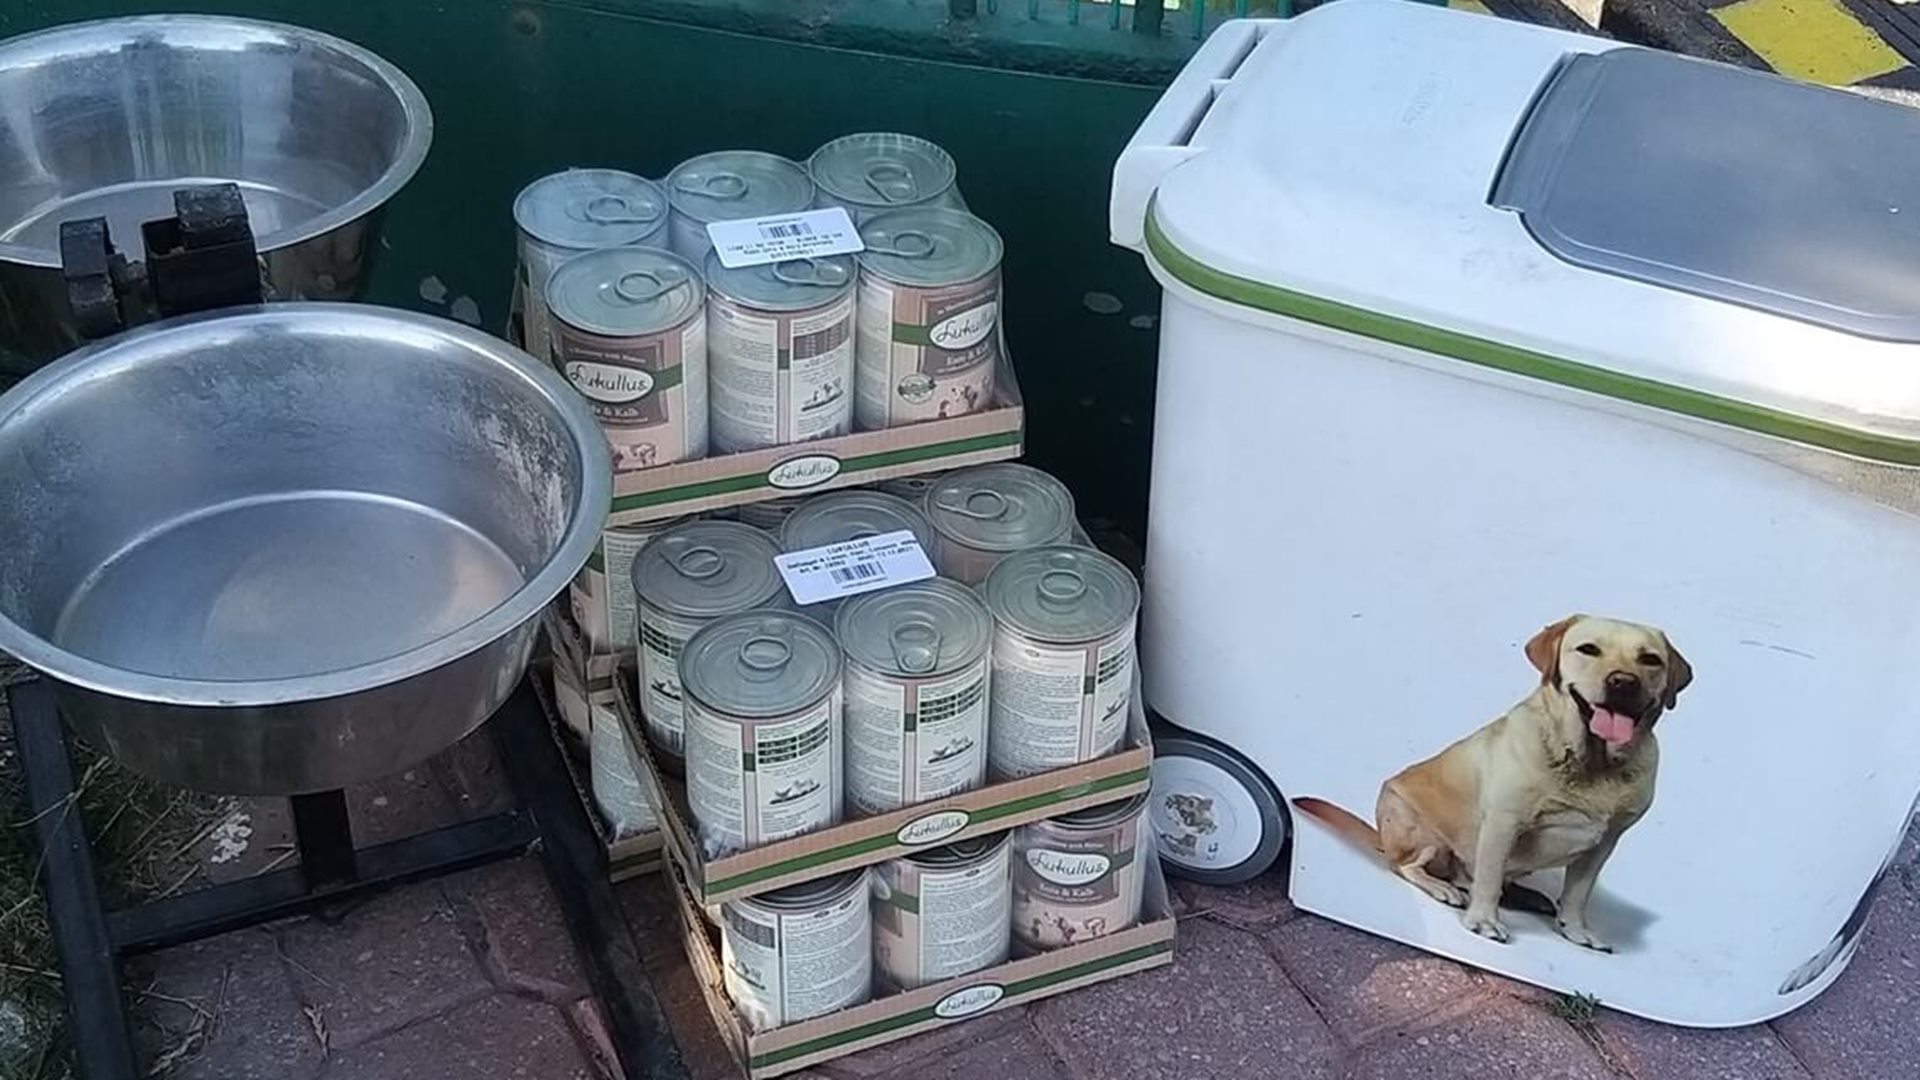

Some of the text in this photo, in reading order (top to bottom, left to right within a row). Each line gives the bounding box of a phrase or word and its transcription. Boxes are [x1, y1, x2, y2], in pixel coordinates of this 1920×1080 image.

[570, 364, 648, 392] Lukullus
[774, 462, 833, 482] Lukullus
[902, 817, 962, 839] Lukullus
[1030, 851, 1104, 876] Lukullus
